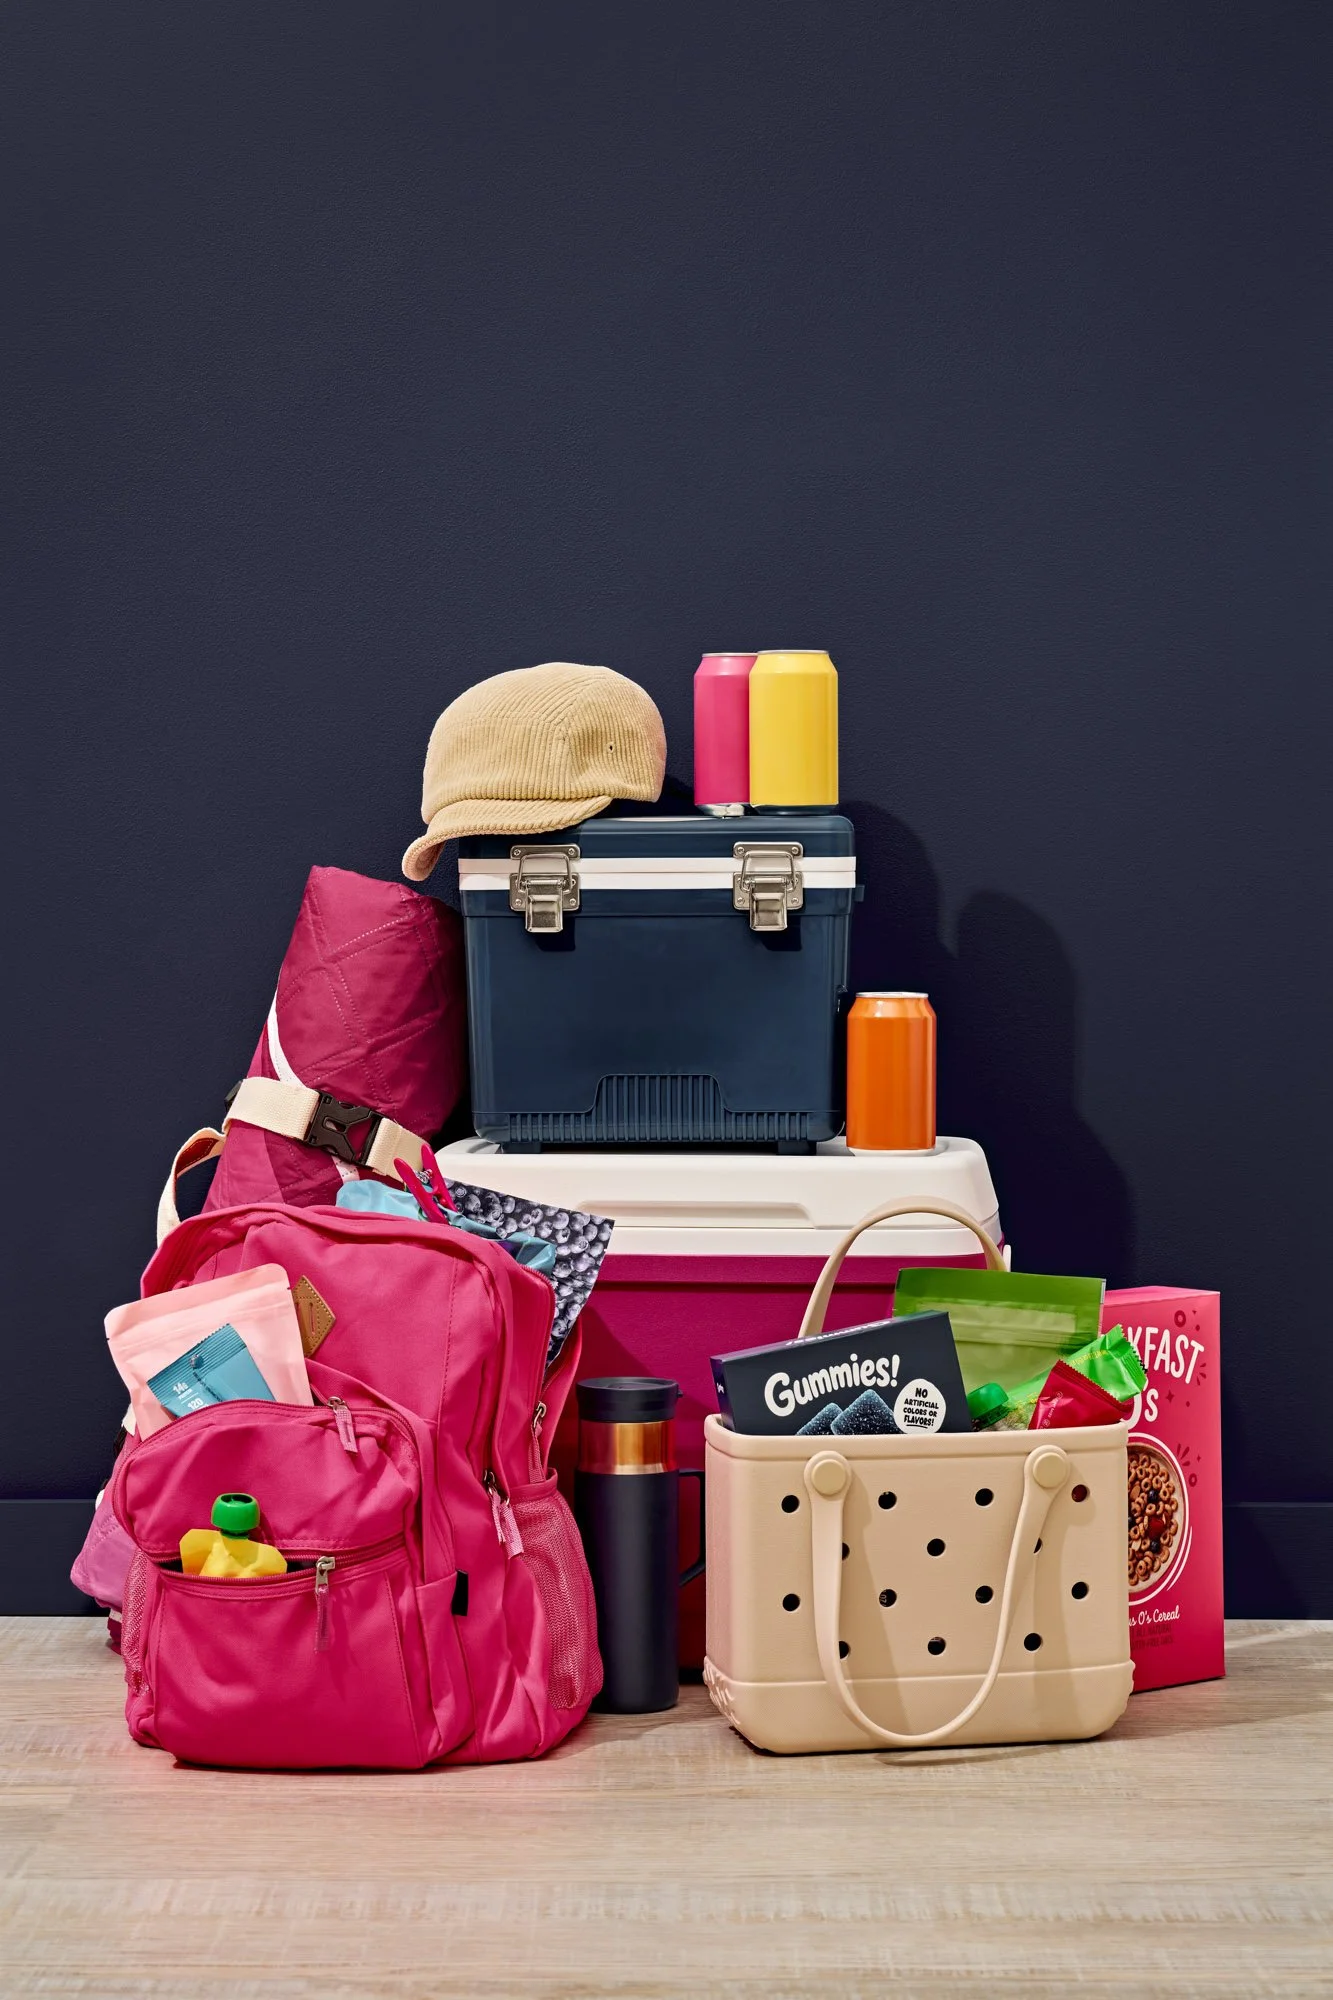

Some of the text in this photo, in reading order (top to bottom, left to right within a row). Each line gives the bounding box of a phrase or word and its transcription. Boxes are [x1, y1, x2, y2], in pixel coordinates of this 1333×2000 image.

[1127, 1326, 1205, 1384] KFAST
[764, 1353, 900, 1417] Gummies!
[915, 1387, 928, 1398] NO
[187, 1397, 204, 1409] 120
[904, 1398, 939, 1410] ARTIFICIAL
[903, 1407, 938, 1418] COLORS OR
[903, 1414, 935, 1427] FLAVORS!
[1138, 1610, 1152, 1625] O's
[1152, 1604, 1180, 1623] Cereal
